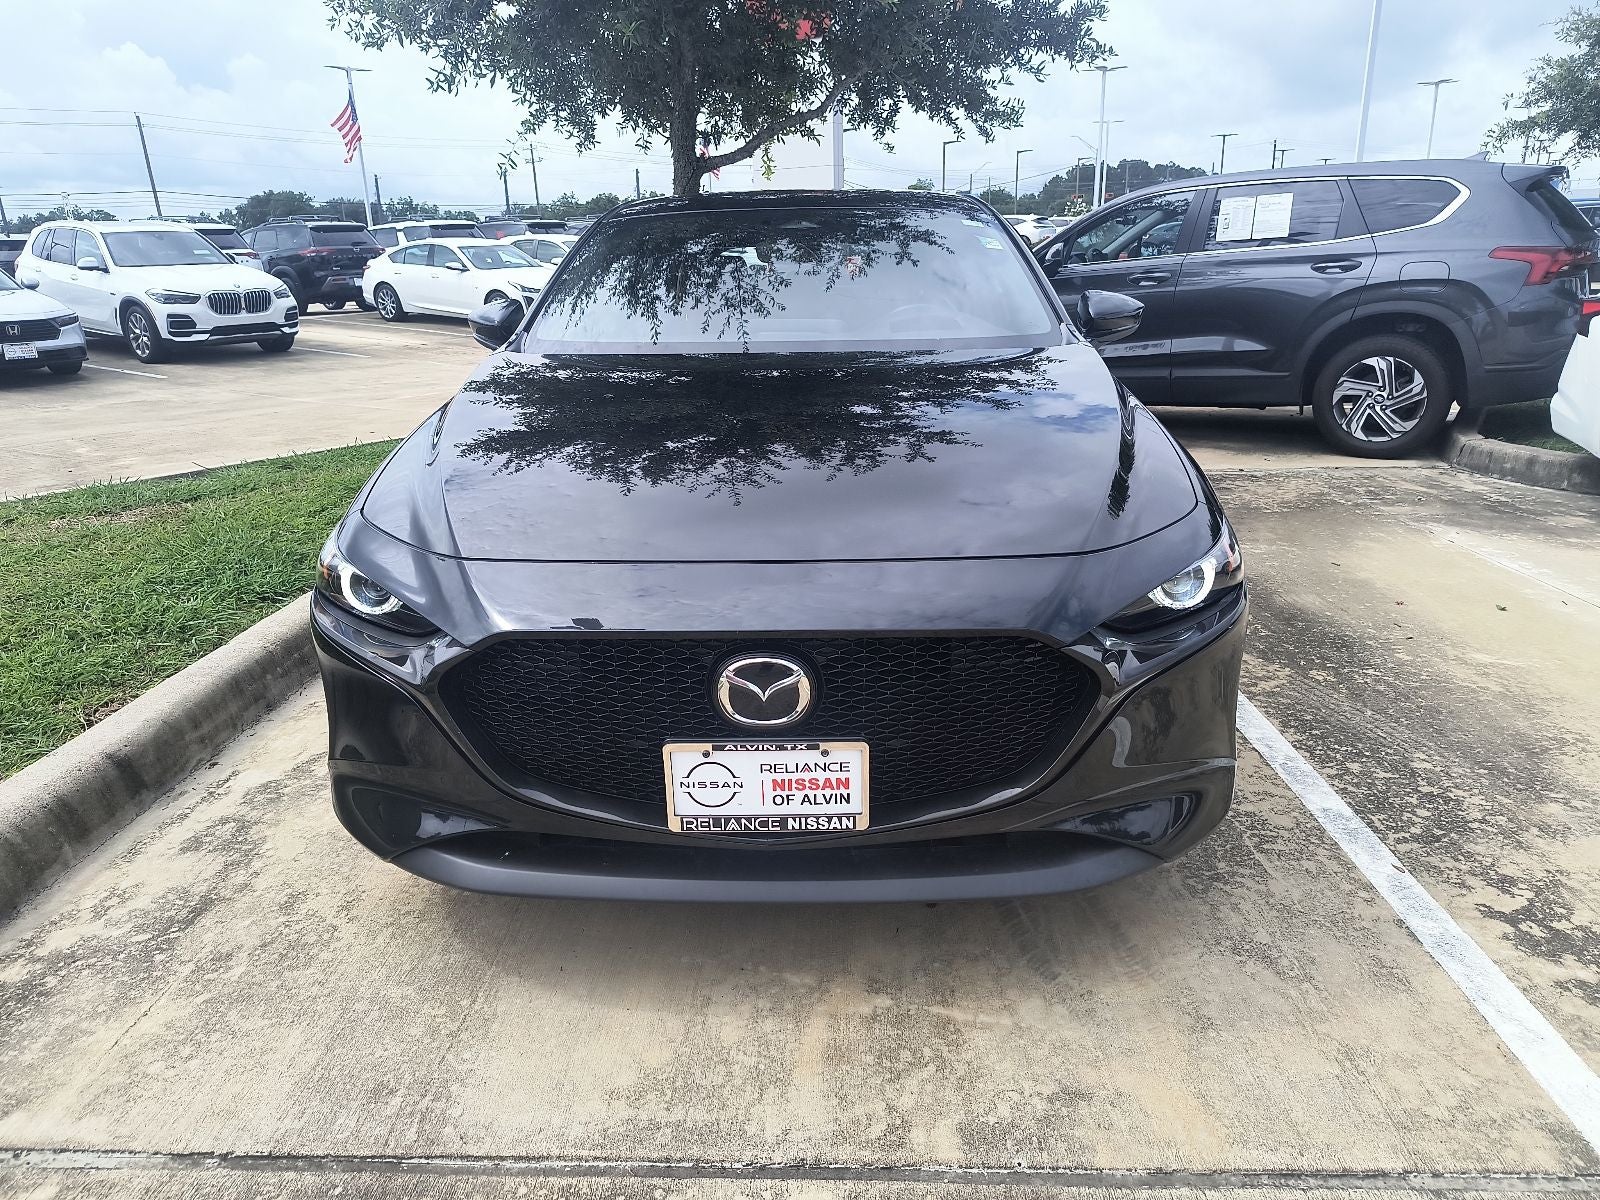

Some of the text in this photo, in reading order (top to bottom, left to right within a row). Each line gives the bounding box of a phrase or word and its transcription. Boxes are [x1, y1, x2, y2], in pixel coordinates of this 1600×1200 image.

[760, 762, 851, 774] RELIANCE
[680, 781, 744, 789] NISSAN
[771, 777, 850, 792] NISSAN
[772, 792, 851, 806] OF ALVIN
[682, 816, 854, 831] RELIANCE NISSAN
